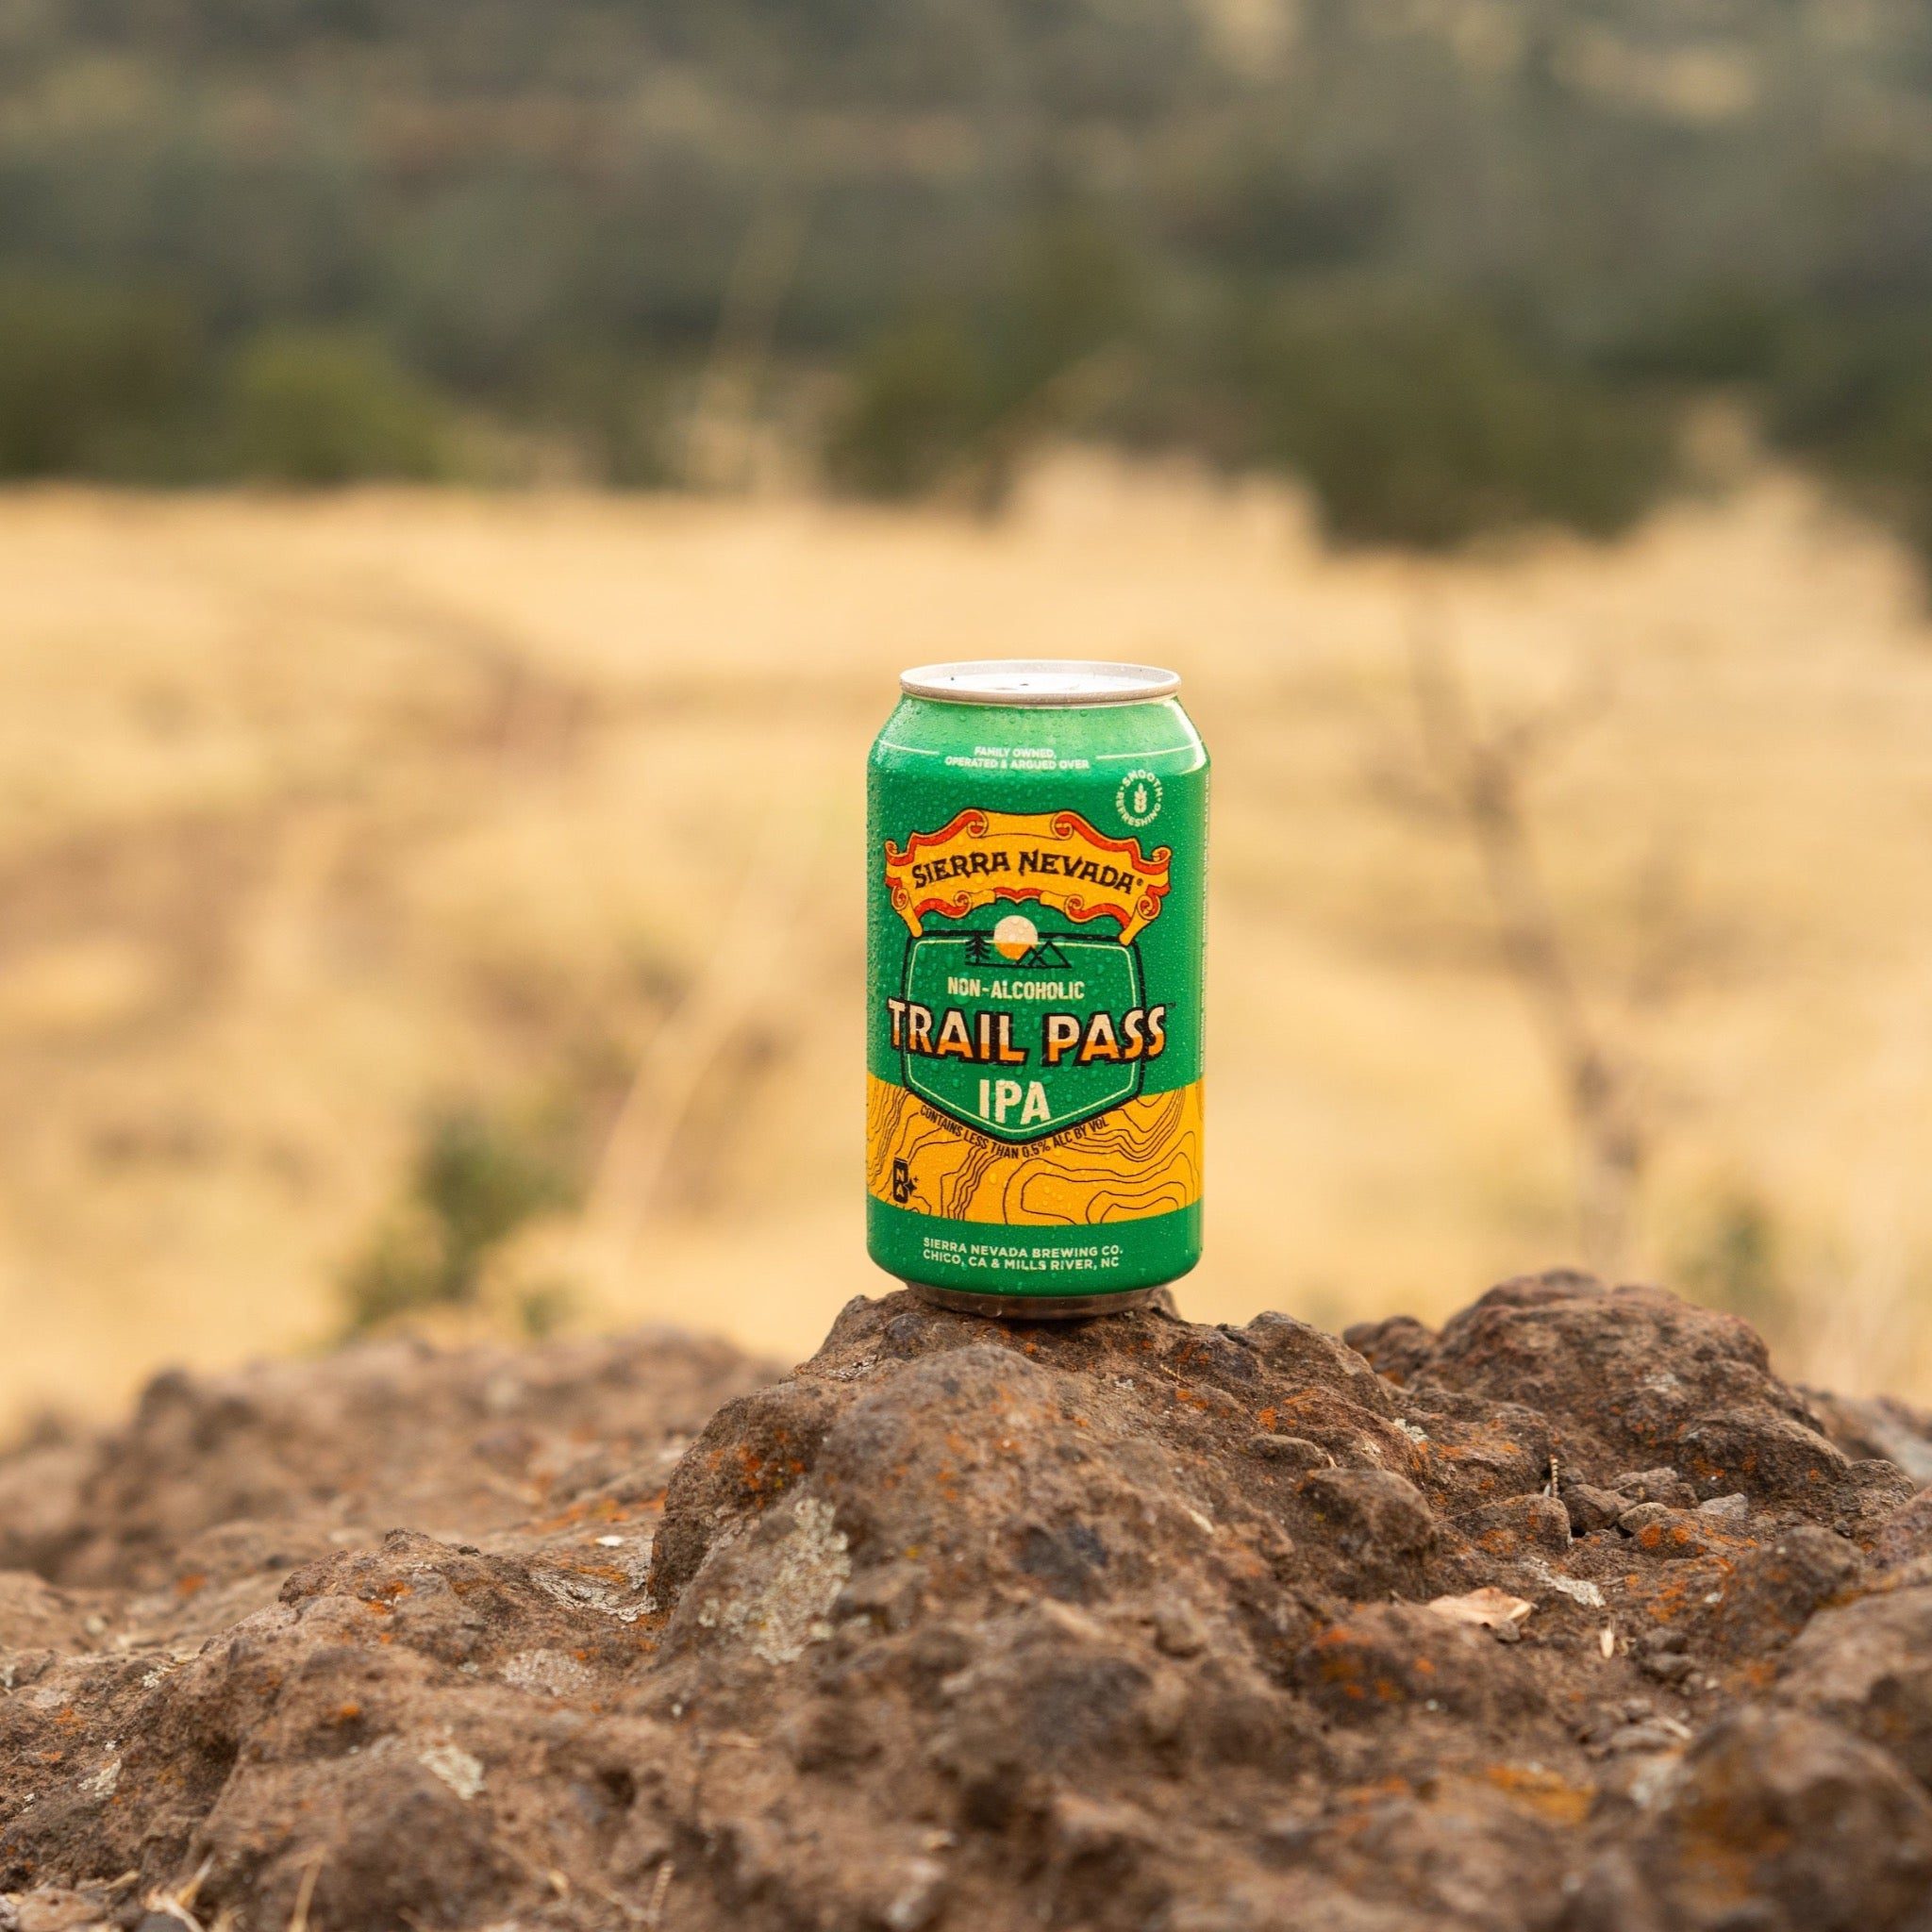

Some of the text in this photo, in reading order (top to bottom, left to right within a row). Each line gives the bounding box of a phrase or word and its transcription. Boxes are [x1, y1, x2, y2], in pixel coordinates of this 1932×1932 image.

[944, 756, 1090, 770] OPERATED & ARGUED OVER
[974, 745, 1010, 758] FAMILY
[1122, 769, 1163, 797] SMOOTH
[1115, 791, 1161, 827] REFRESHING
[911, 851, 1010, 889] SIERRA
[947, 976, 1085, 1000] NON-ALCOHOLIC
[887, 997, 1167, 1066] TRAIL PASS
[978, 1078, 1051, 1124] IPA
[920, 1105, 1109, 1159] CONTAINS LESS THAN 0.5% ALC BY VOL
[923, 1237, 1124, 1258] SIERRA NEVADA BREWING CO.
[923, 1249, 1120, 1271] CHICO, CA & MILLS RIVER, NC
